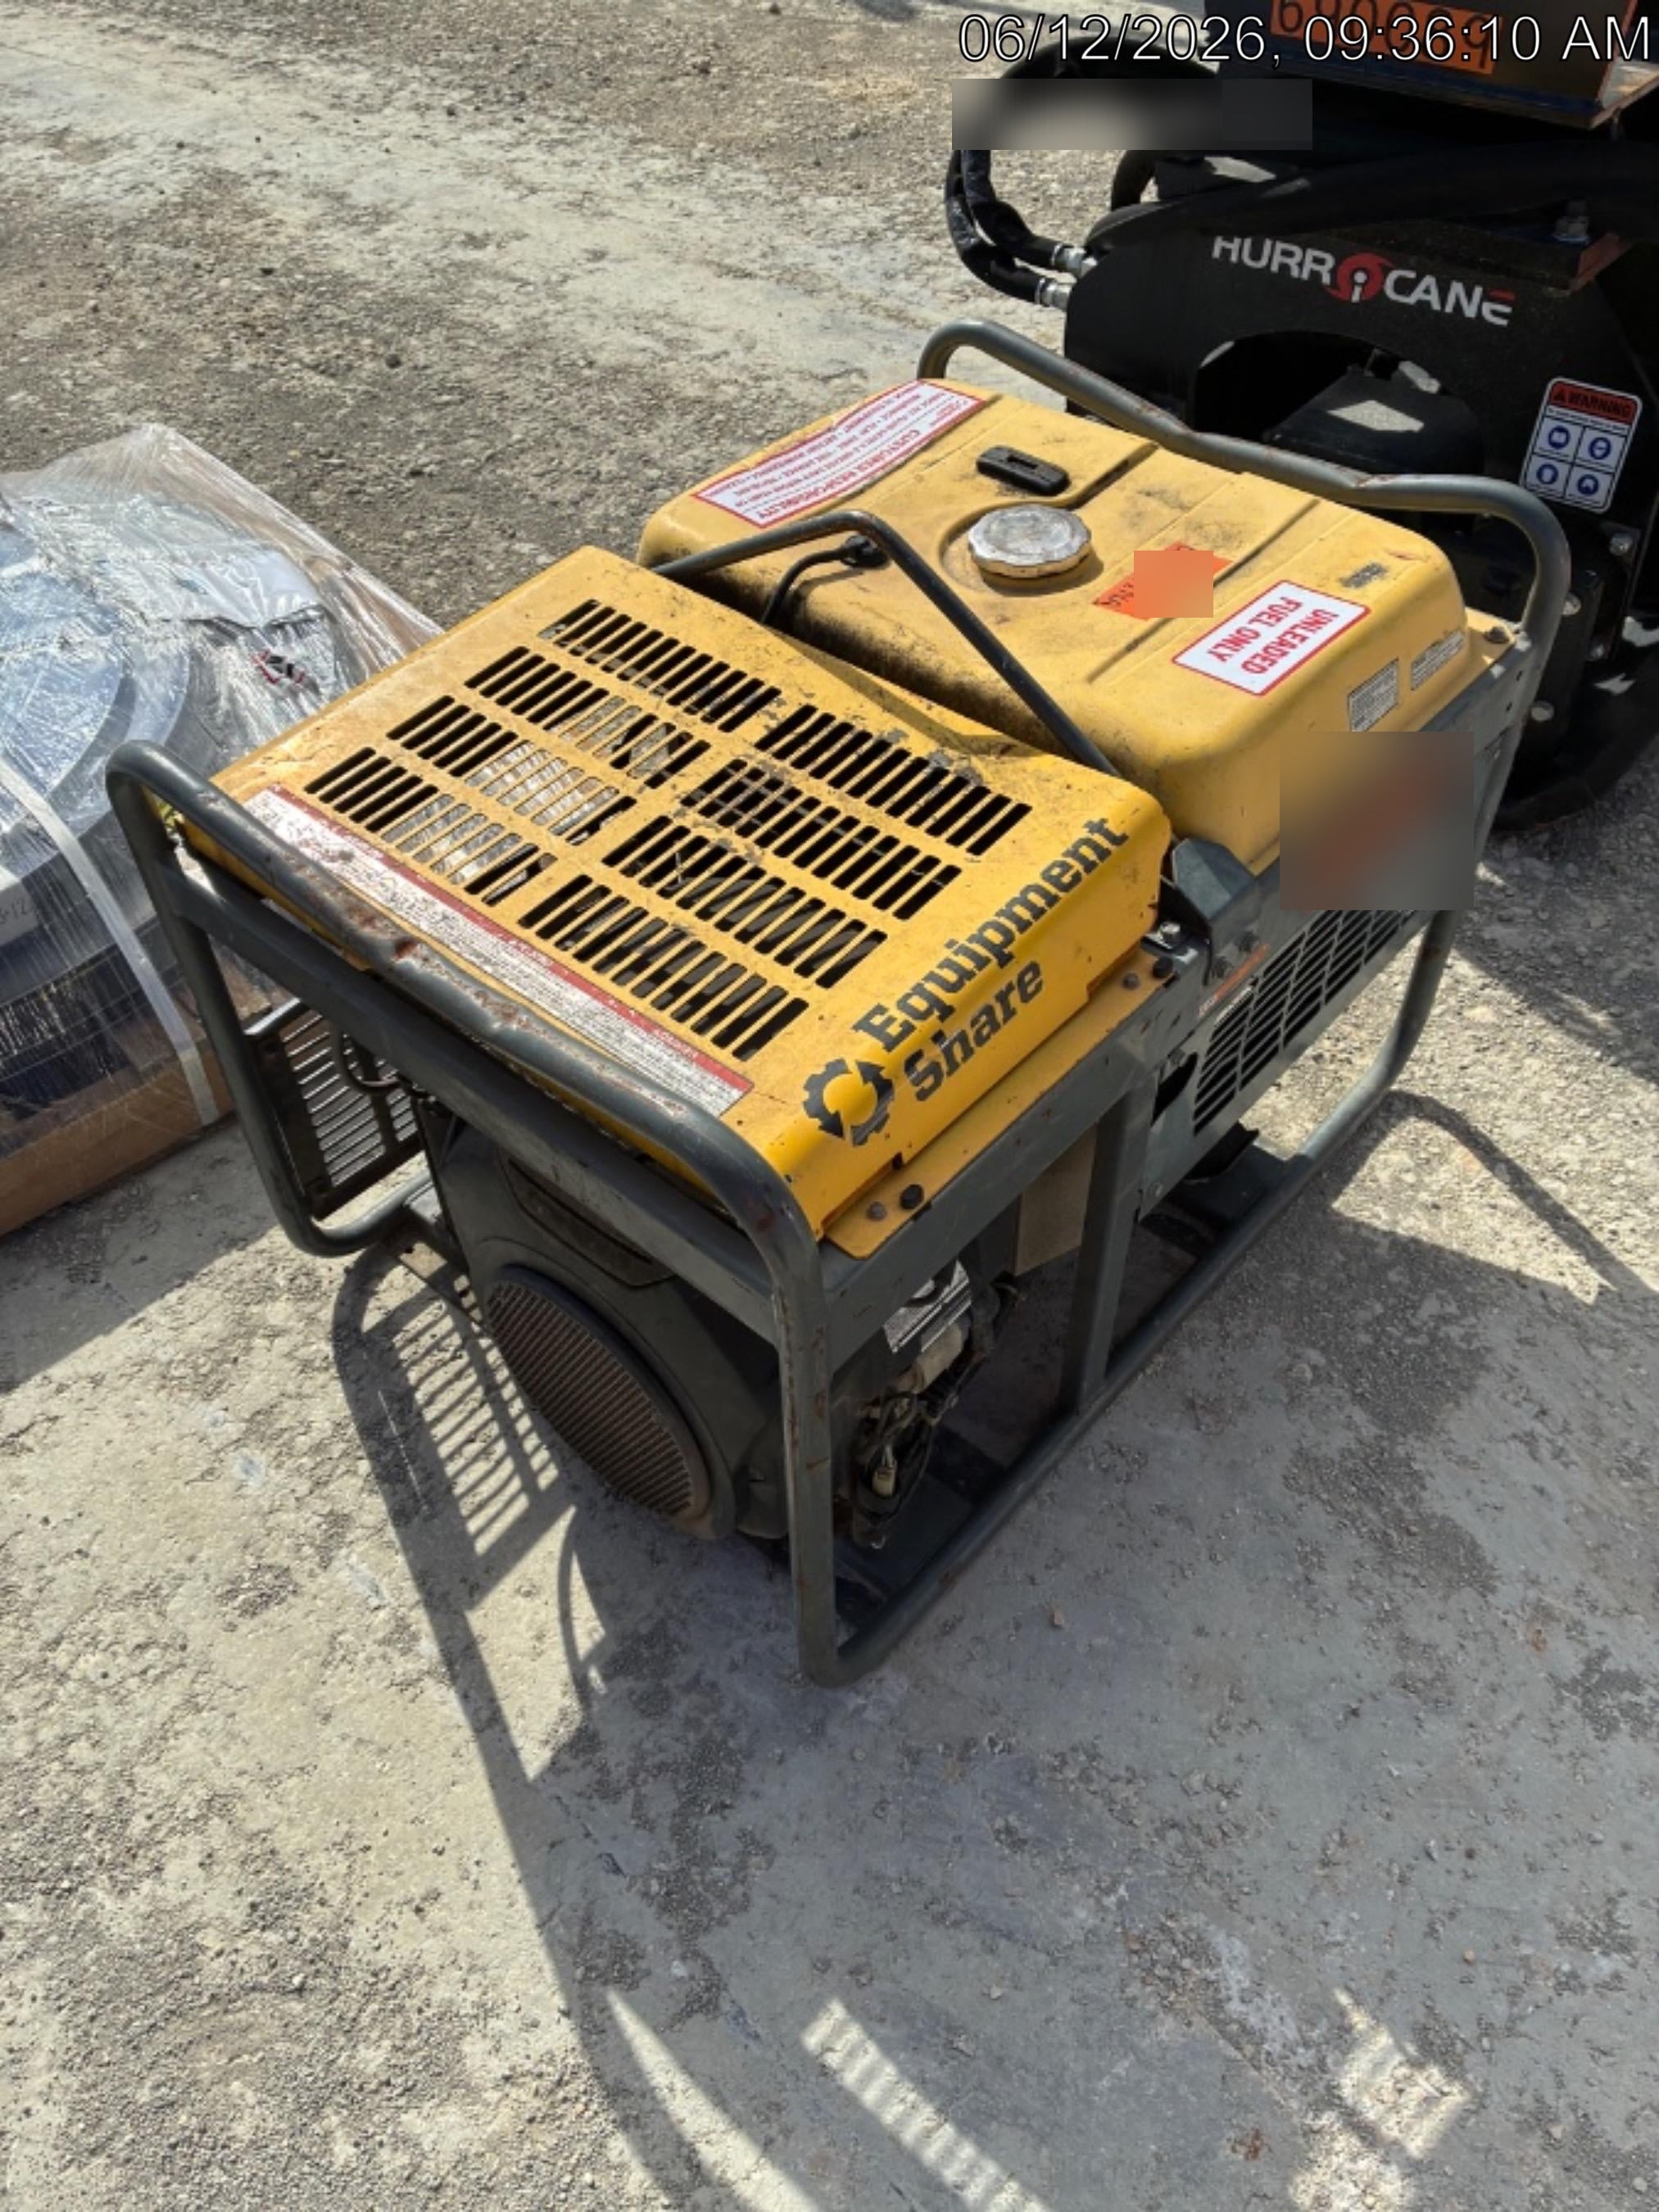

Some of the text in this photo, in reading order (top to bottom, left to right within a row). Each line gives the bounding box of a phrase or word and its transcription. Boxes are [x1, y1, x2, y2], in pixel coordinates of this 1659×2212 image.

[1208, 596, 1303, 662] FUEL ONLY
[1241, 609, 1339, 673] UNLEADED
[851, 817, 1129, 1053] Equipment
[903, 959, 1045, 1102] Share
